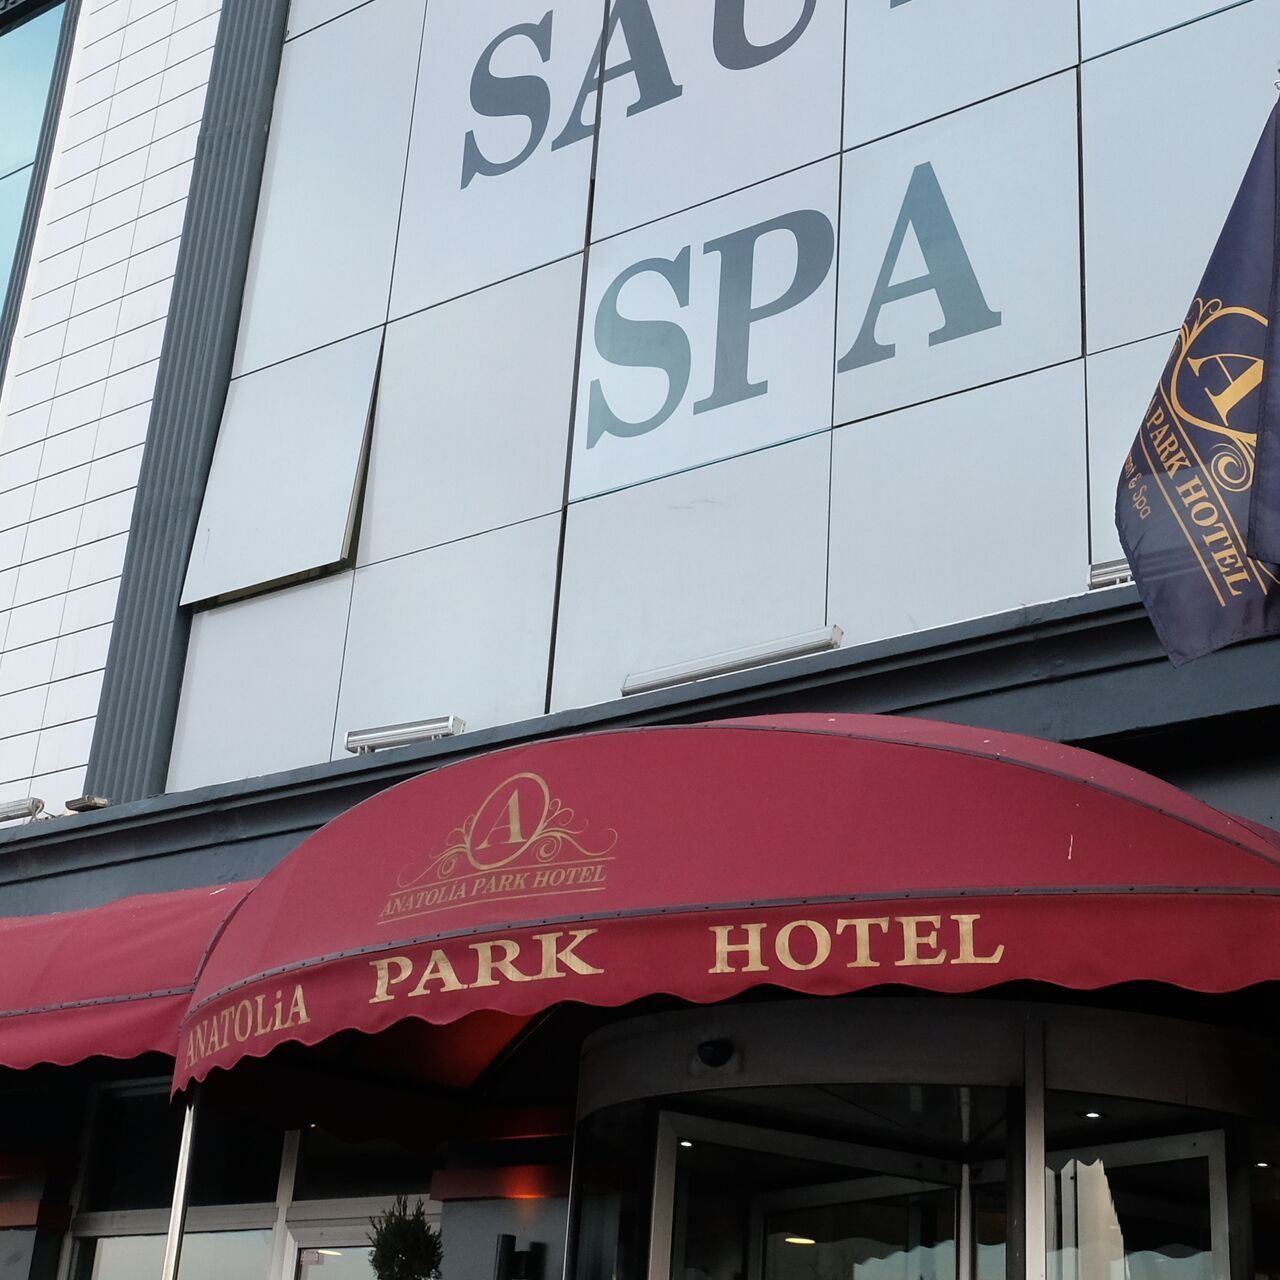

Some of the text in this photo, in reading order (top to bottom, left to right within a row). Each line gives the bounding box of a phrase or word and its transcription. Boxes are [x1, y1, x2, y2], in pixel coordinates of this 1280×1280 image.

[585, 160, 1002, 451] SPA
[1146, 406, 1252, 598] PARK HOTEL
[475, 788, 527, 851] A
[471, 871, 532, 896] PARK
[531, 864, 608, 889] HOTEL
[368, 928, 605, 1005] PARK
[708, 913, 1005, 974] HOTEL
